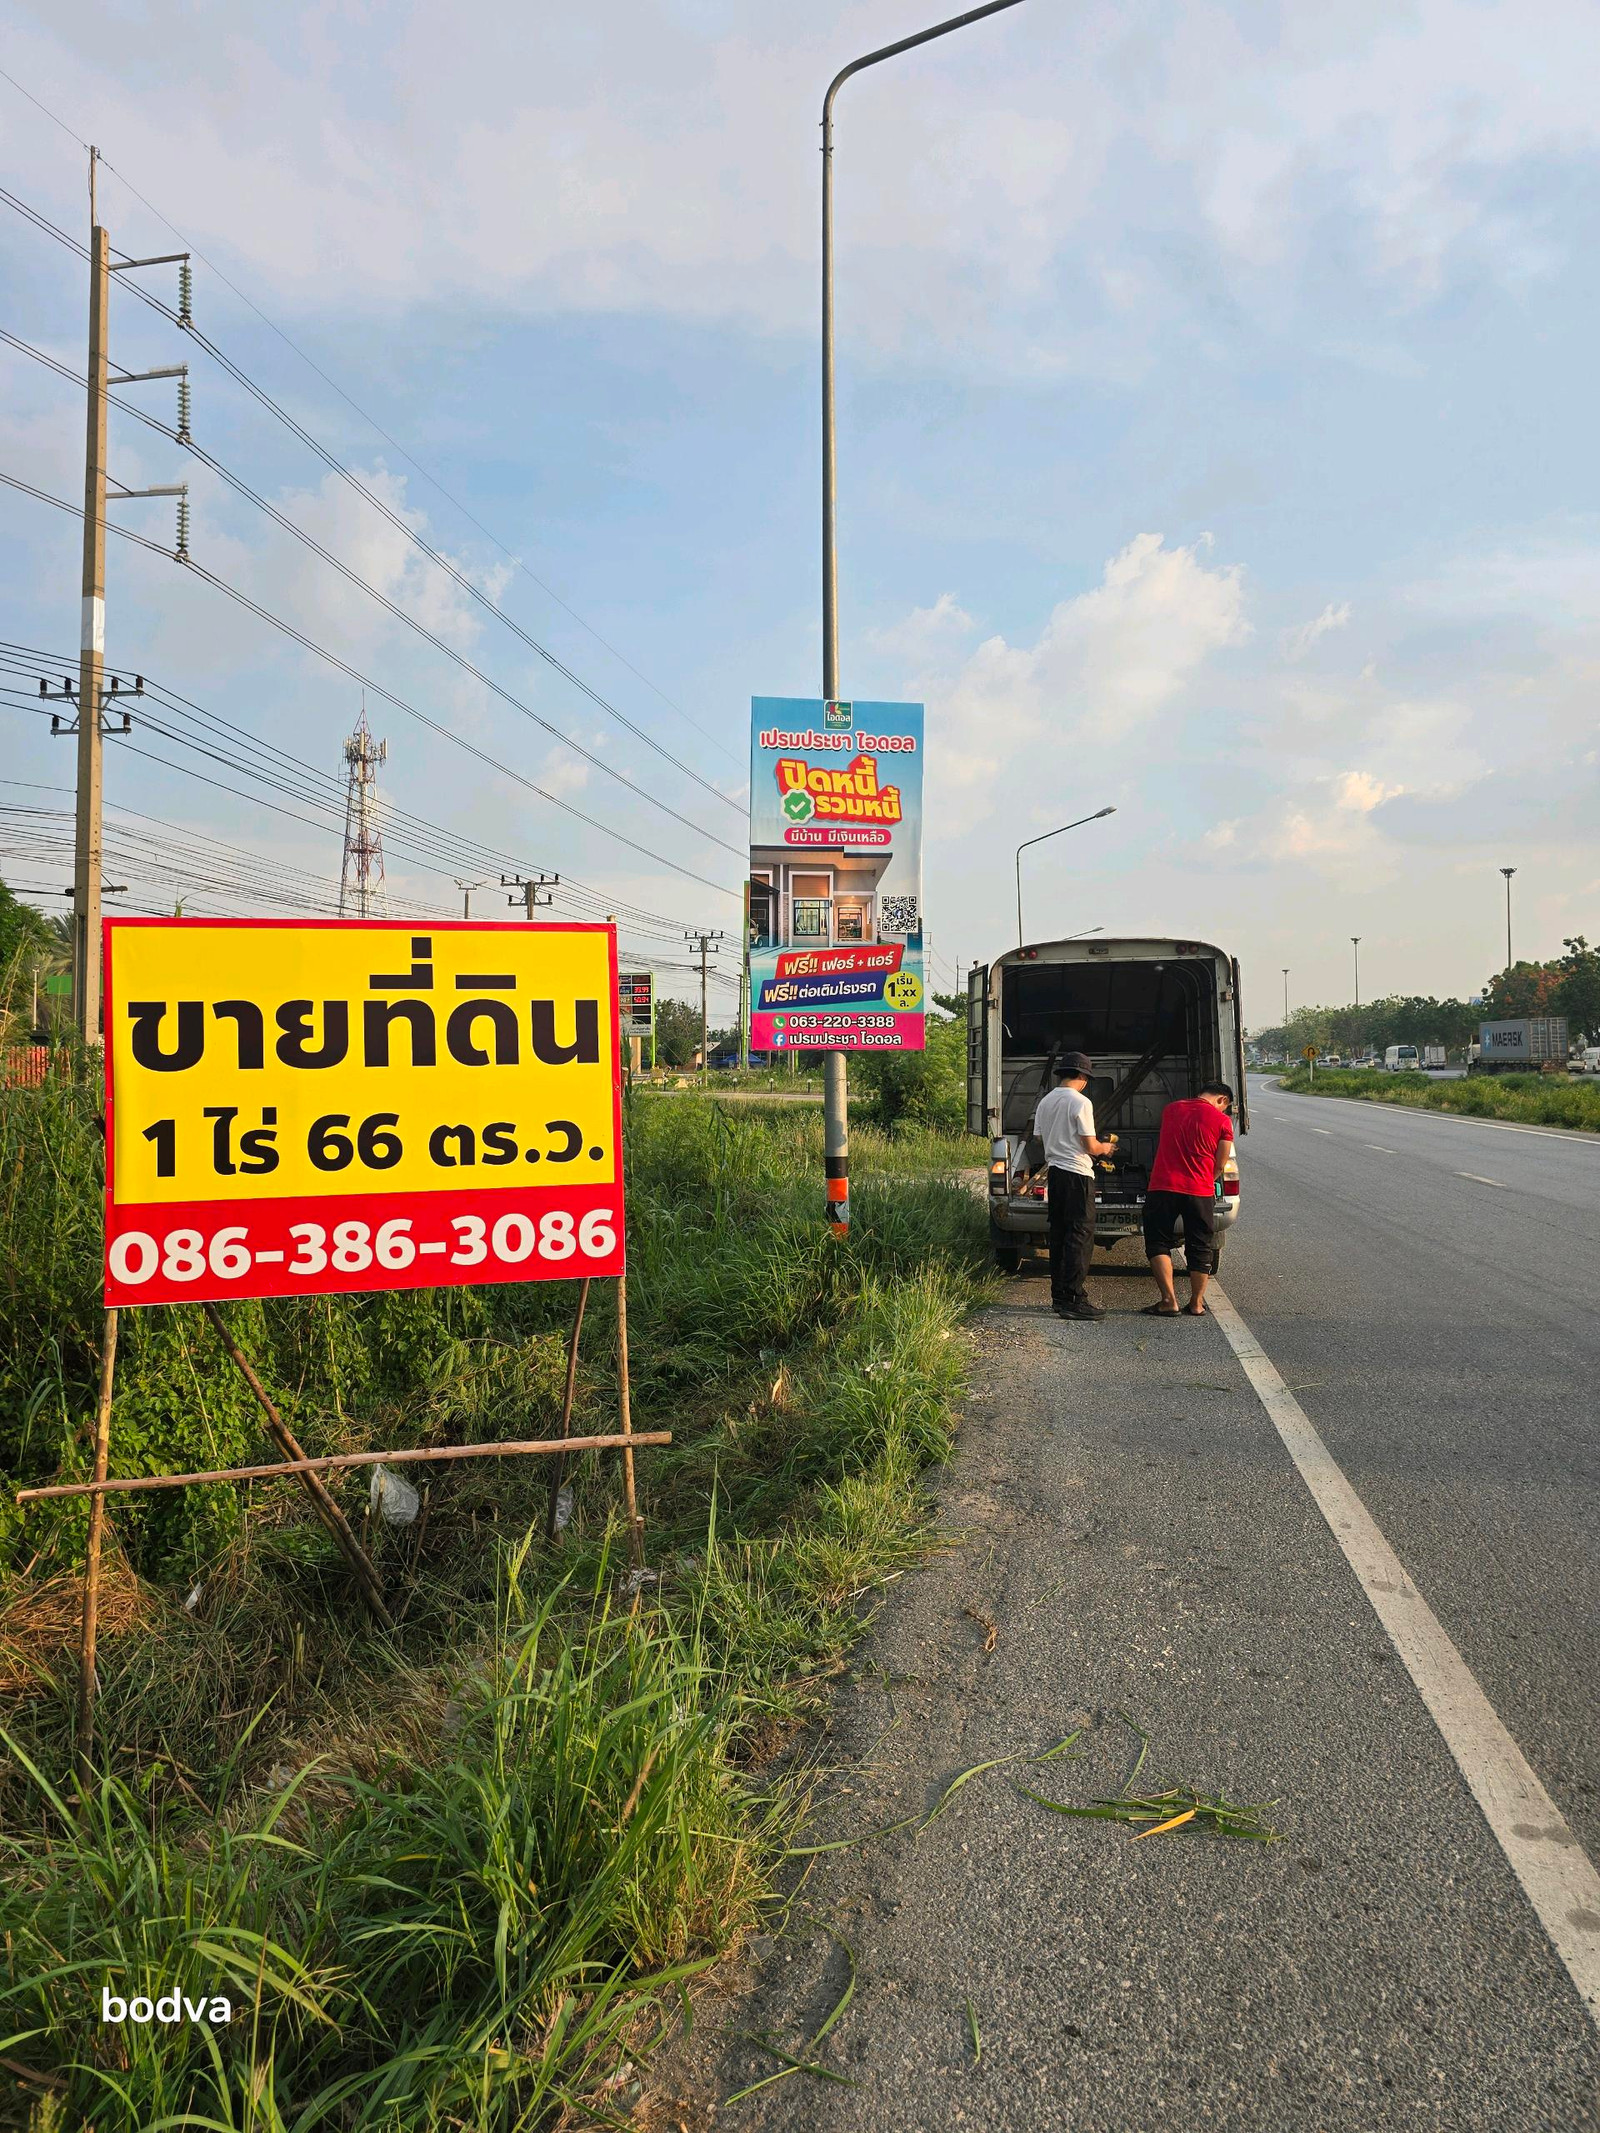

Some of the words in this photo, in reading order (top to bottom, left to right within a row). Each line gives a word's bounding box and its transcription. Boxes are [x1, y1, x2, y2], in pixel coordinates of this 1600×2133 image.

[760, 729, 851, 749] เปรมประชา
[857, 732, 915, 750] ไอดอล
[781, 757, 877, 796] ปิดหนี้
[816, 787, 901, 819] รวมหนี้
[791, 830, 822, 842] มีบ้าน
[828, 830, 885, 842] มีเงินเหลือ
[821, 955, 855, 971] เฟอร์
[867, 952, 894, 967] แอร์
[896, 973, 913, 985] เริ่ม
[127, 937, 600, 1072] ขายที่ดิน
[789, 1016, 895, 1028] 063-220-3388
[789, 1032, 857, 1045] เปรมประชา
[1492, 1031, 1523, 1047] MAERSK
[142, 1119, 176, 1178] 1
[203, 1106, 280, 1175] ไร่
[307, 1112, 403, 1172] 66
[428, 1120, 605, 1167] ตร.ว.
[108, 1208, 617, 1285] 086-386-3086
